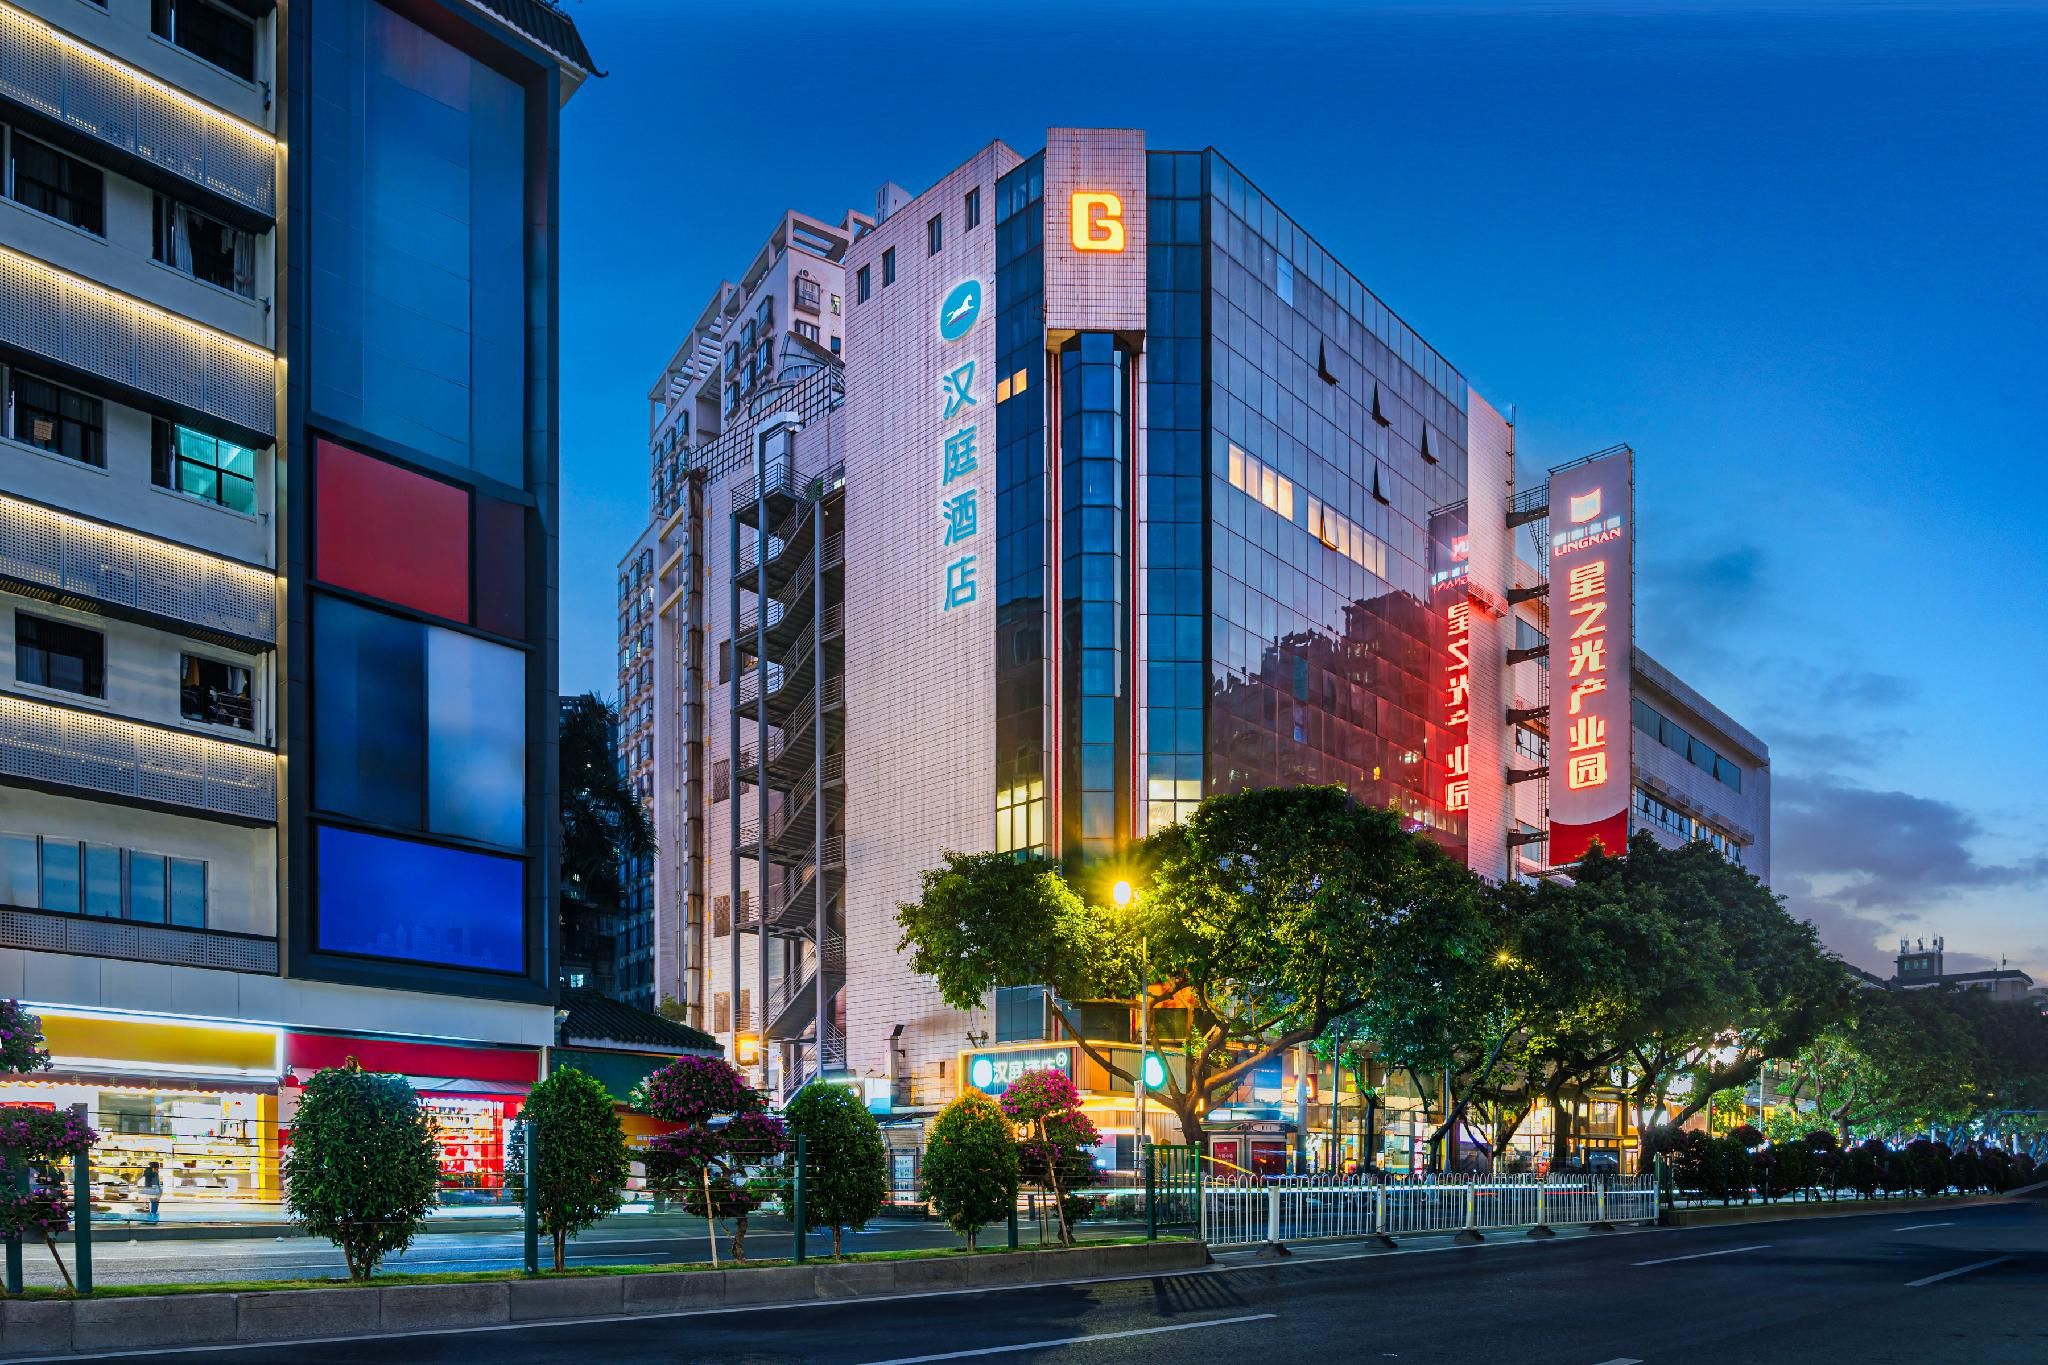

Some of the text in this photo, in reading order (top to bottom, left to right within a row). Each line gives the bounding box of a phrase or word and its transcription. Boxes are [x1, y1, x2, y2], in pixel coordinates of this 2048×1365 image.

[943, 360, 978, 612] 汉庭酒店
[1554, 527, 1622, 557] LINGNAN
[1568, 560, 1607, 790] 星之光产业园
